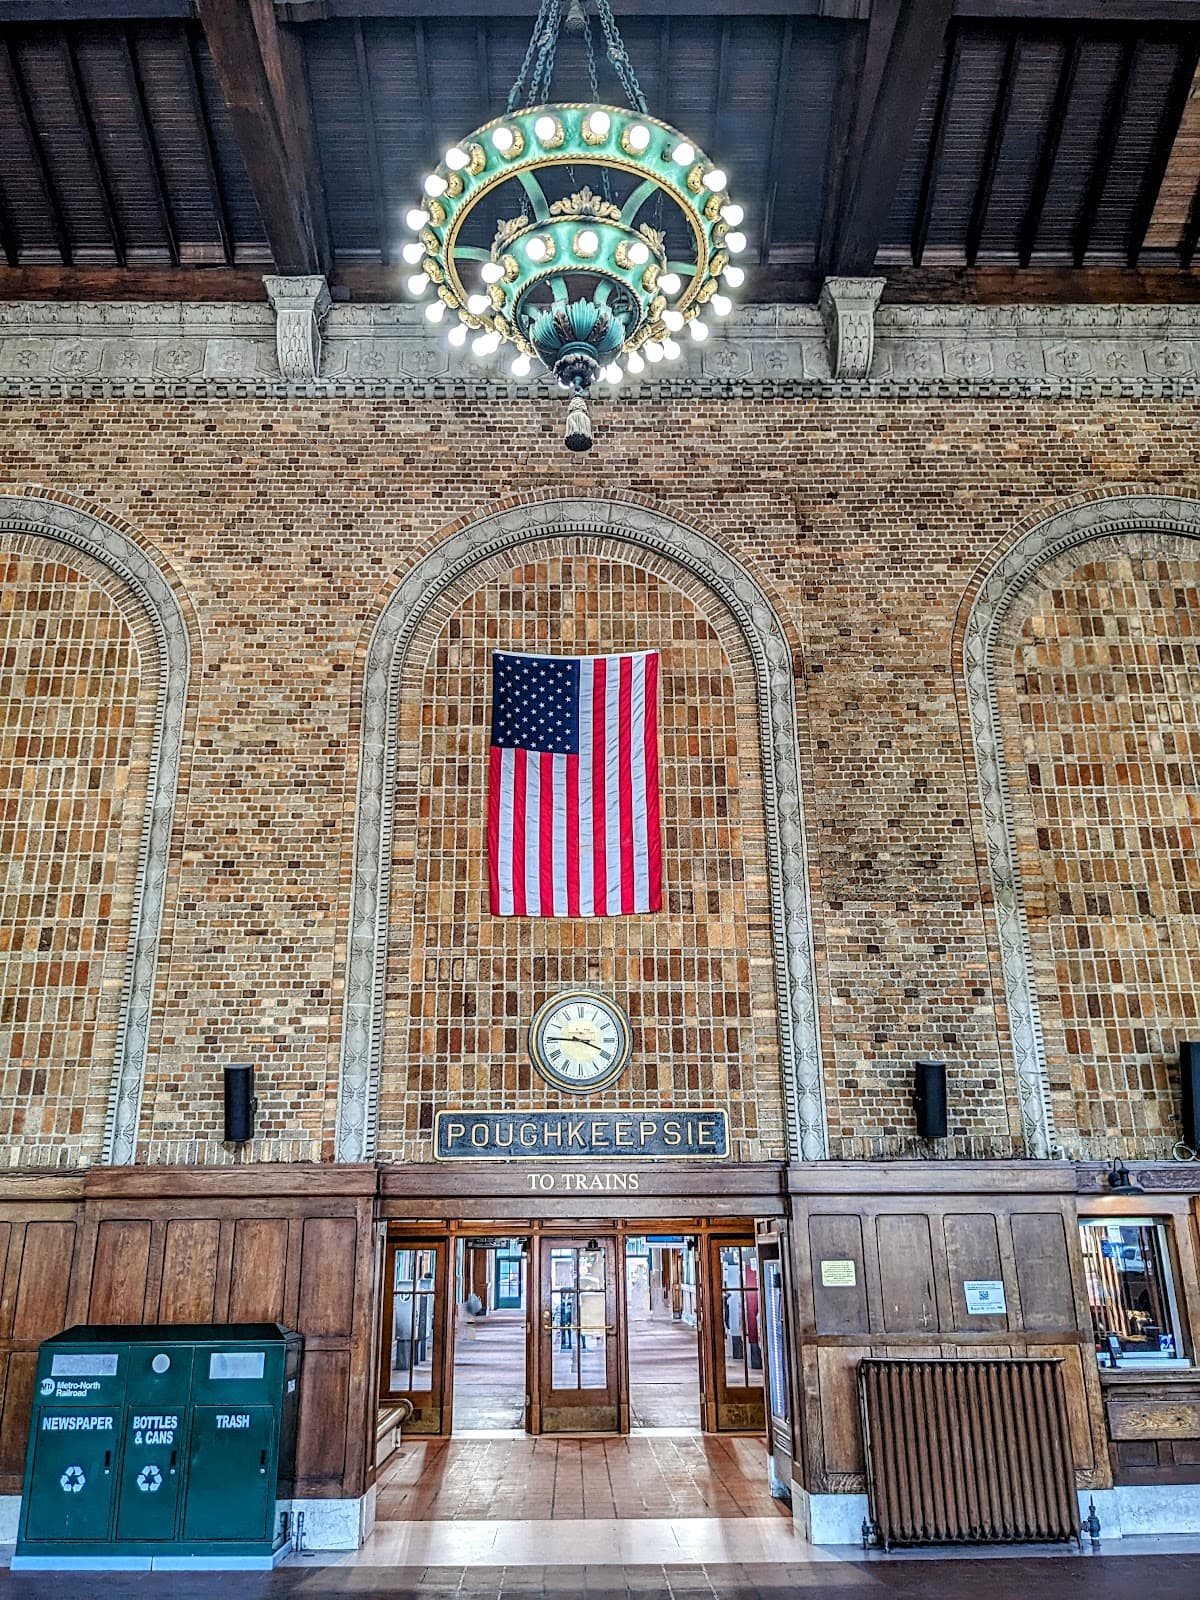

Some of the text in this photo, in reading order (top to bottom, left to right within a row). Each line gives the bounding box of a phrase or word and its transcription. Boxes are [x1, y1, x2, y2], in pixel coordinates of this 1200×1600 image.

[447, 1121, 717, 1148] POUGHKEEPSIE
[527, 1173, 639, 1190] TO TRAINS
[57, 1381, 100, 1390] Metro-North
[56, 1389, 87, 1397] Railroad
[43, 1416, 113, 1430] NEWSPAPER
[133, 1415, 178, 1429] BOTTLES
[216, 1414, 250, 1428] TRASH
[134, 1430, 174, 1444] & CANS
